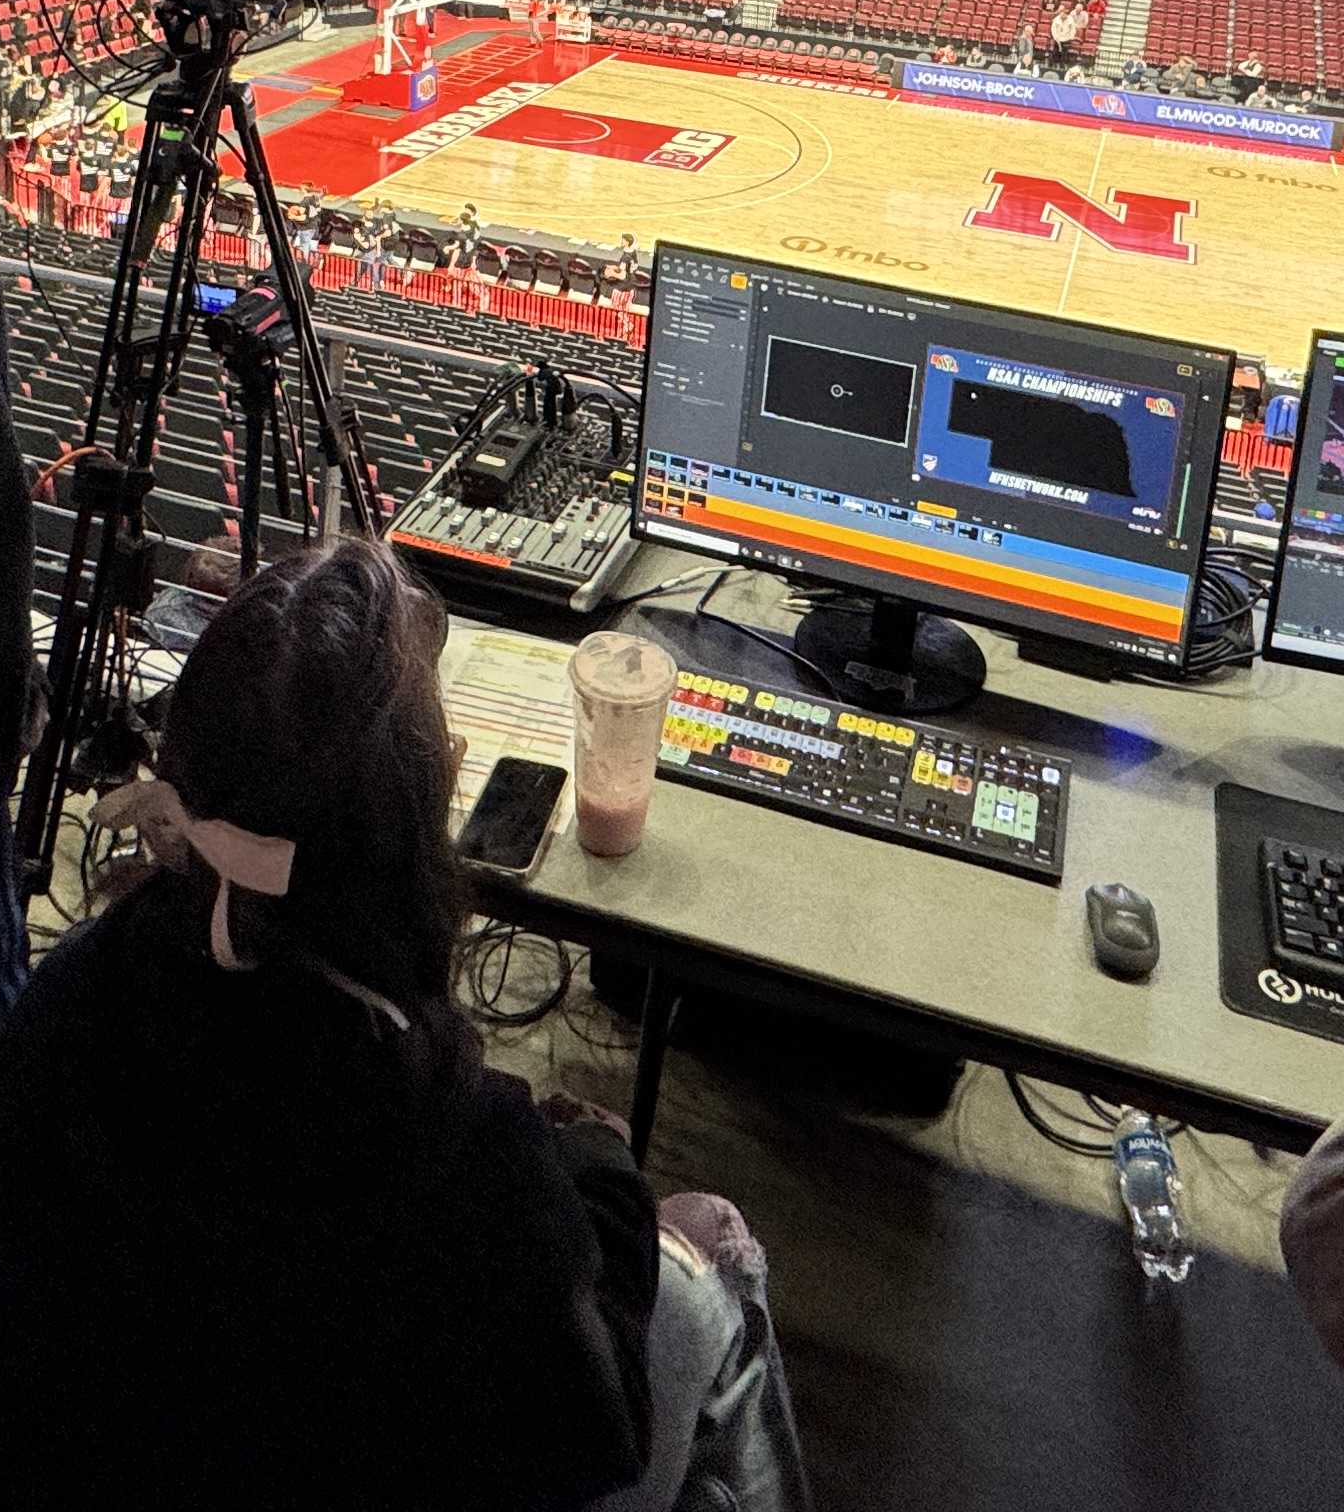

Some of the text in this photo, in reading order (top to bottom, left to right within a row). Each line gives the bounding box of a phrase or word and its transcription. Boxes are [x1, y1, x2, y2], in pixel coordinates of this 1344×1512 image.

[912, 71, 1035, 100] JOHNSON-BROCK
[380, 81, 554, 160] NEBRASKA
[1156, 104, 1321, 141] ELMWOOD-MURDOCK
[1254, 173, 1338, 192] fnbo
[963, 168, 1198, 265] N
[834, 246, 930, 272] fnbo
[986, 367, 1123, 408] NSAA CHAMPIONSHIPS
